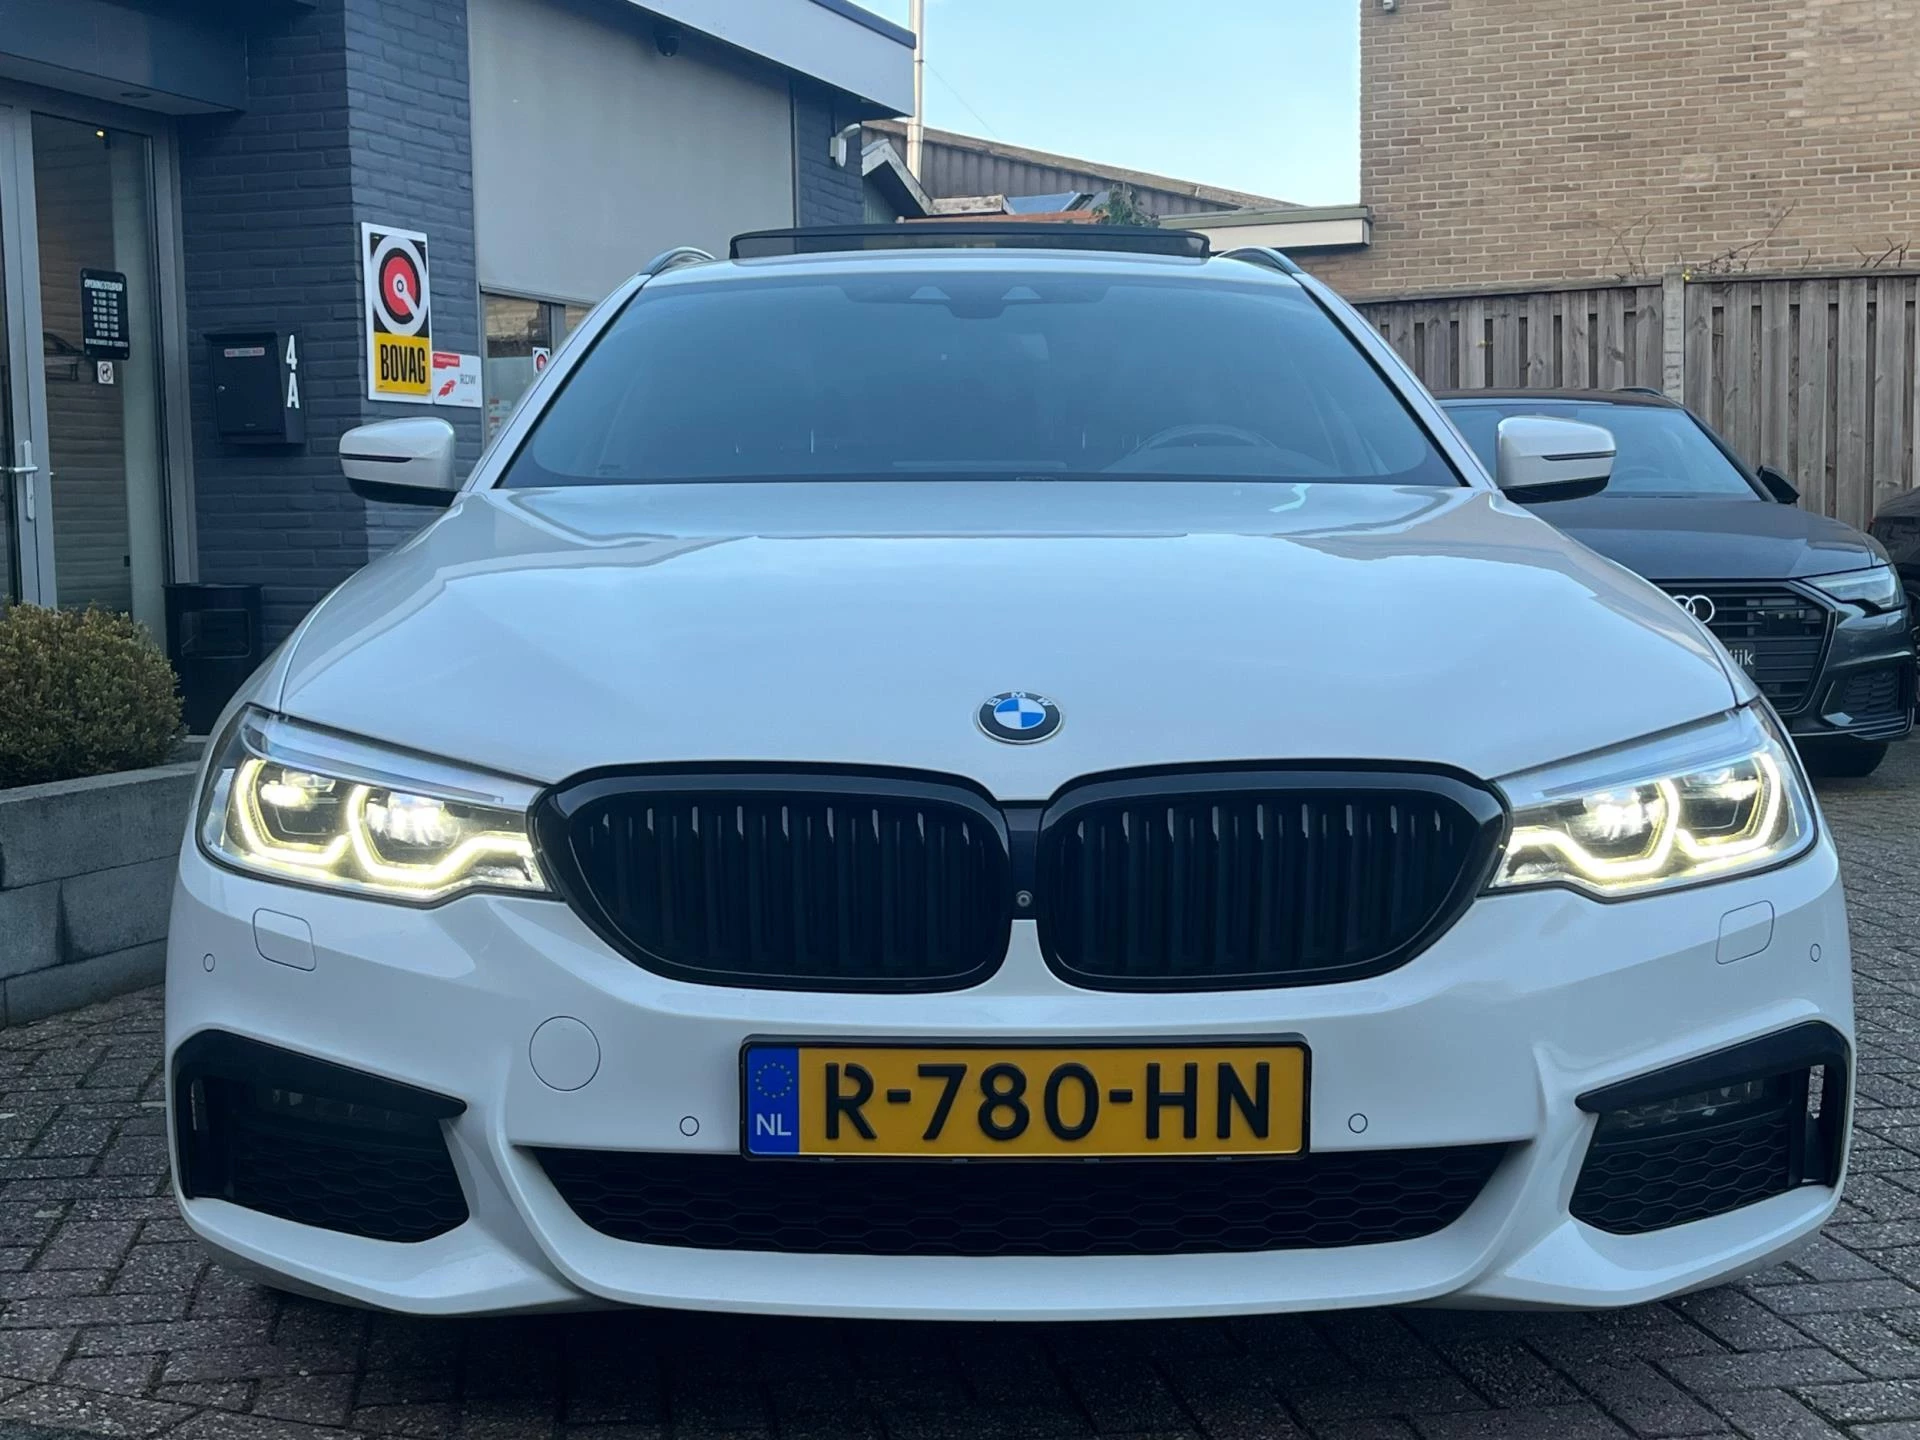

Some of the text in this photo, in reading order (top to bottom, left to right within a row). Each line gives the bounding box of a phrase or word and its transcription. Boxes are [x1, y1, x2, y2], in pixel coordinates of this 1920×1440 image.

[380, 344, 426, 384] BOVAG
[1729, 649, 1754, 668] ijk
[986, 691, 1055, 707] BMW
[824, 1062, 1271, 1142] R-780-HN
[756, 1113, 792, 1137] NL
